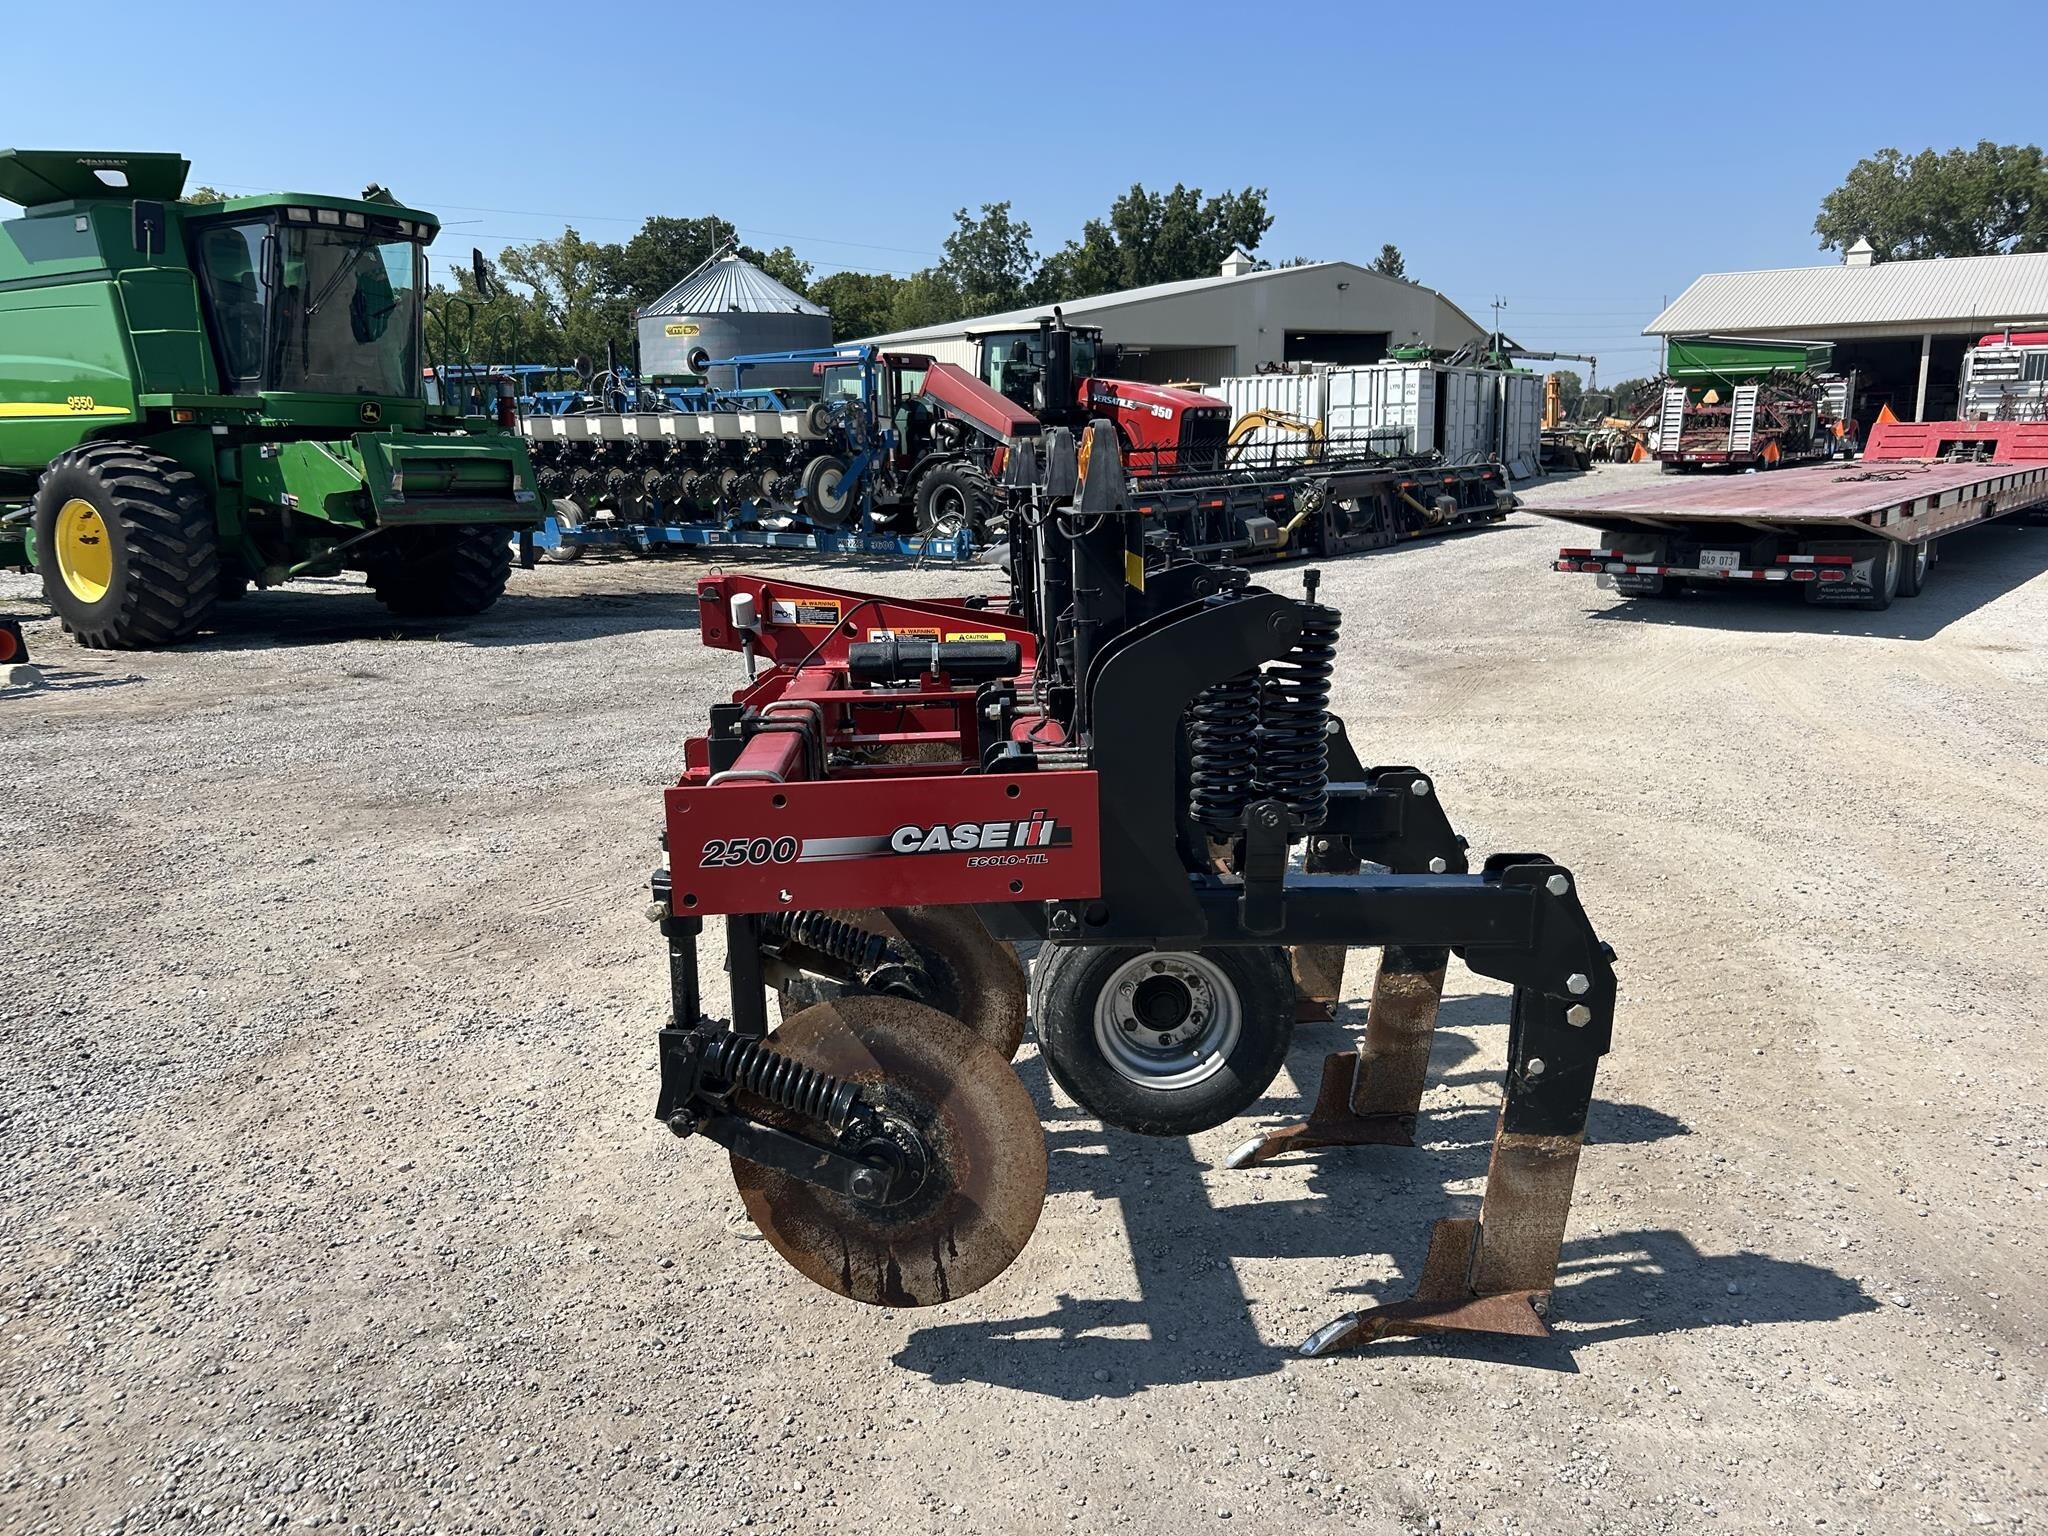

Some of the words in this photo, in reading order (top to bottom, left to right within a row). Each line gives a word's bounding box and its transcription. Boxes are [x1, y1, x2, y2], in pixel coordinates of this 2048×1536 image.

[67, 395, 95, 410] 9550
[1093, 394, 1136, 410] VERSATILE
[1151, 404, 1173, 420] 350
[890, 823, 1012, 853] CASE
[699, 836, 798, 868] 2500
[966, 853, 1049, 868] ECOLO-TIL
